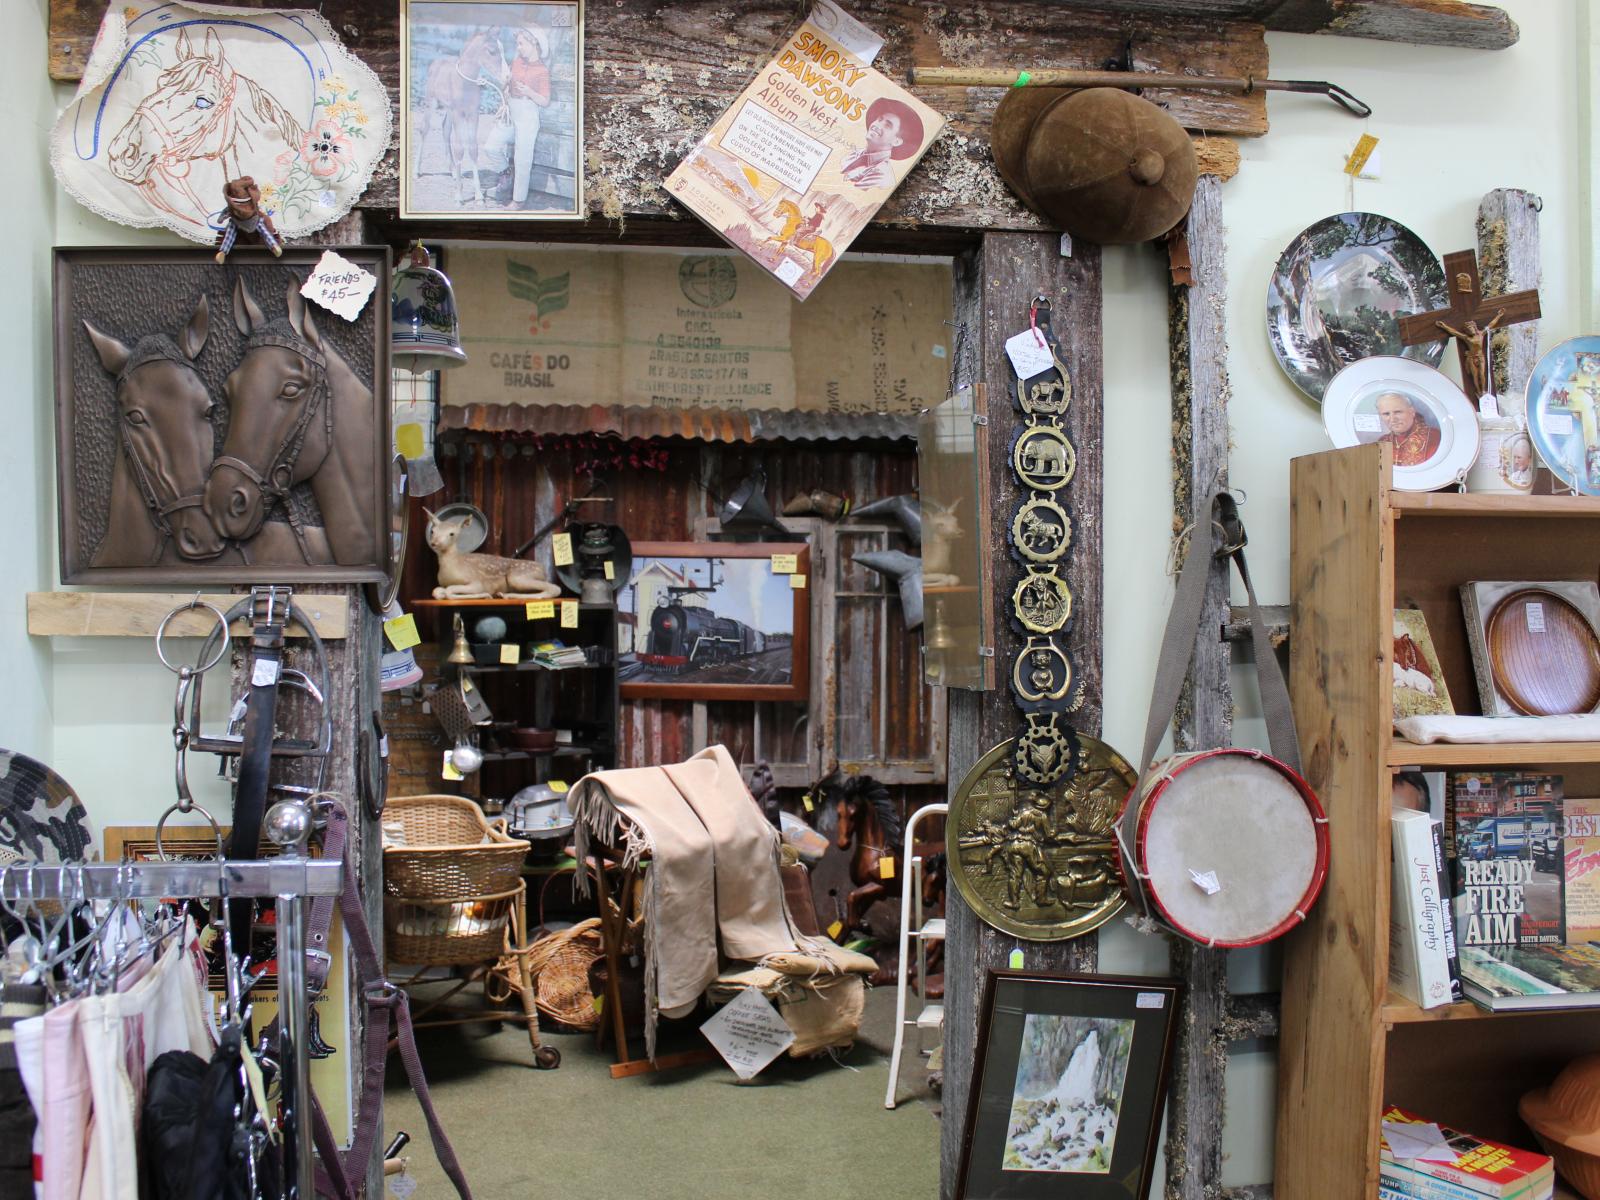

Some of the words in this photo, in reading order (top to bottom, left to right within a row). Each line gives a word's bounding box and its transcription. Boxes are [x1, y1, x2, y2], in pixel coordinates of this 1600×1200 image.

[793, 31, 867, 88] SMOKY
[776, 50, 868, 122] DAWSON'S
[757, 87, 801, 124] Album
[766, 72, 807, 109] Golden
[810, 100, 838, 129] West
[489, 350, 544, 371] CAFÉS
[546, 354, 571, 370] DO
[703, 351, 750, 364] SANTOS
[503, 371, 555, 388] BRASIL
[1563, 815, 1600, 838] BEST
[1414, 857, 1430, 884] Just
[1462, 860, 1536, 885] READY
[1465, 885, 1524, 914] FIRE
[1419, 887, 1439, 951] Calligraphy
[1465, 913, 1517, 944] AIM
[1443, 931, 1456, 959] POWER
[1520, 935, 1538, 943] KEITH
[1539, 935, 1560, 944] DAVIES
